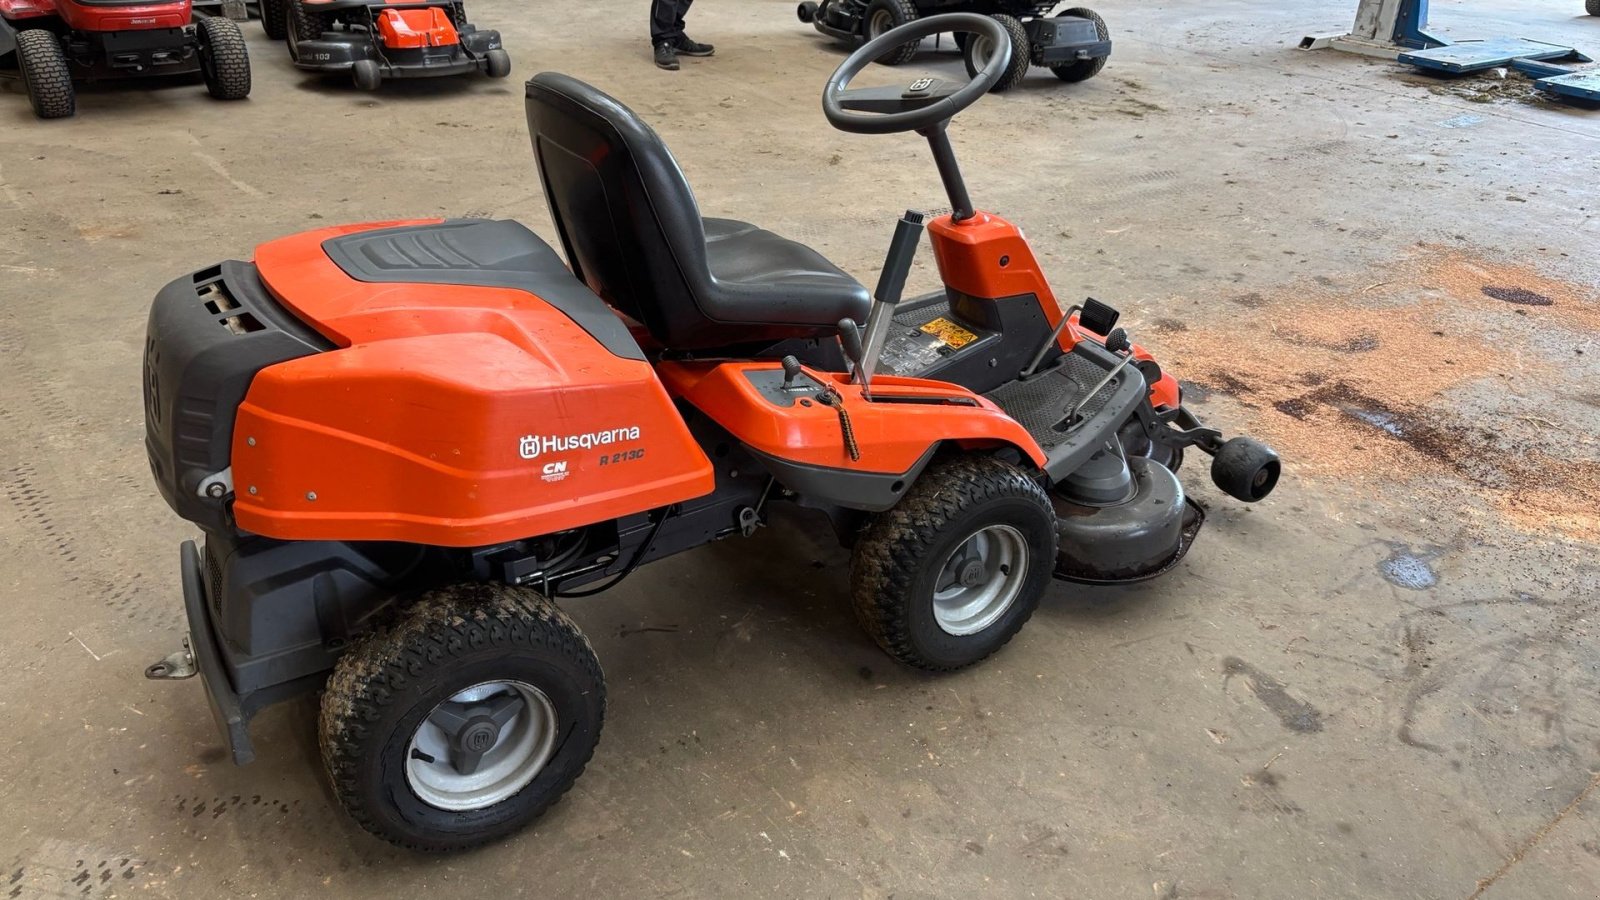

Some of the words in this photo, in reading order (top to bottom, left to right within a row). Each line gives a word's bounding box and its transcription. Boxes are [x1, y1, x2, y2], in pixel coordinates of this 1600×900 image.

[542, 426, 640, 453] Husqvarna
[600, 455, 609, 465] R
[612, 448, 645, 463] 213C
[542, 461, 567, 474] CN
